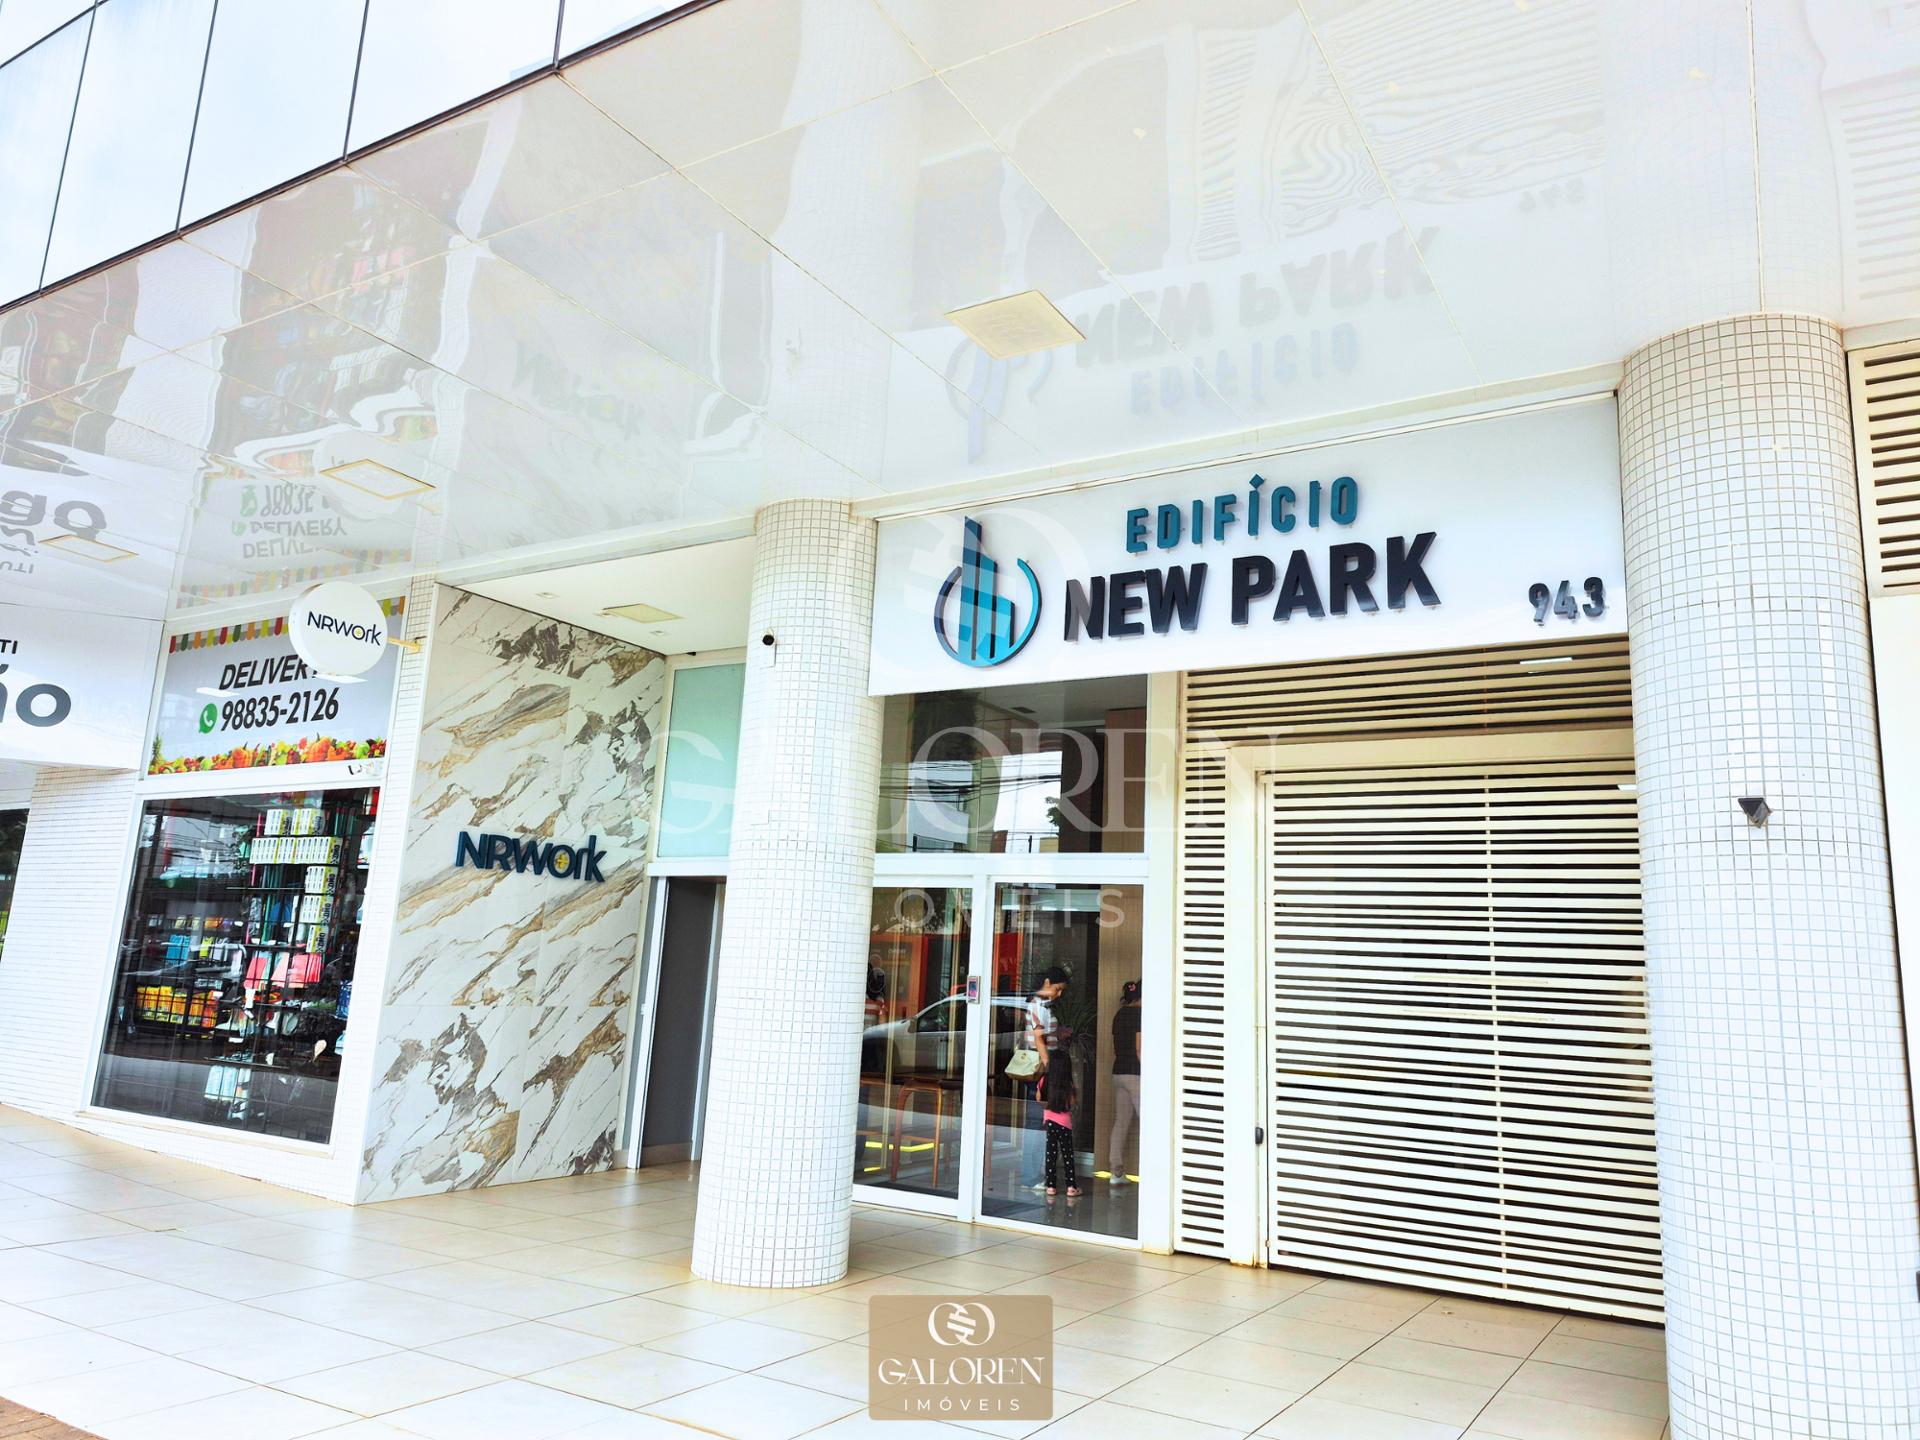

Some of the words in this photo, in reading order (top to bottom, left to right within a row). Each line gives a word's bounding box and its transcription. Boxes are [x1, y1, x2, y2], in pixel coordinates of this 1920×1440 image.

[1126, 473, 1359, 554] EDIFÍCIO
[1064, 562, 1208, 641] NEW
[1231, 531, 1442, 625] PARK
[1528, 577, 1605, 623] 943
[219, 654, 318, 690] DELIVER
[221, 687, 340, 731] 98835-2126
